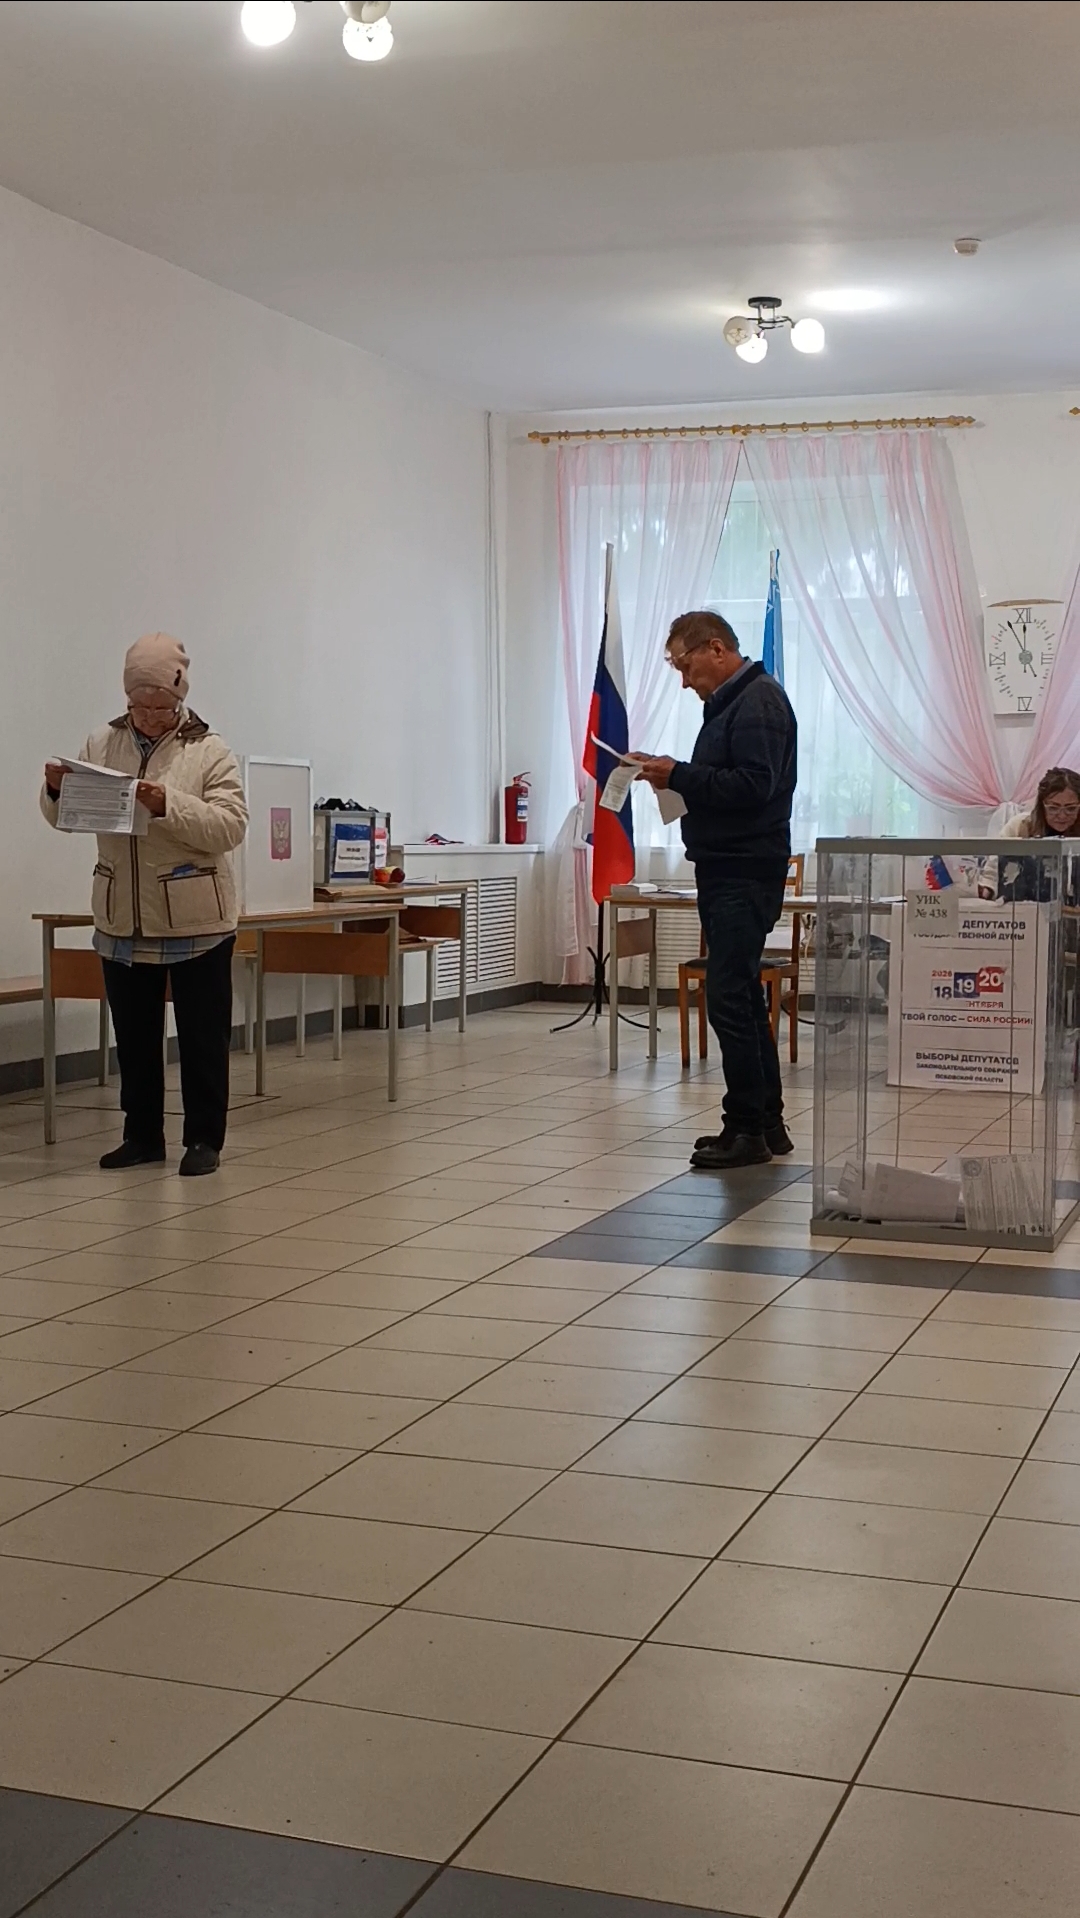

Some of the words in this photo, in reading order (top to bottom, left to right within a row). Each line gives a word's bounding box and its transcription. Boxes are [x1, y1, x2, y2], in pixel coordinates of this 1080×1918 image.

[1012, 607, 1034, 624] XII
[916, 895, 941, 904] УИК
[914, 909, 927, 918] №
[929, 909, 948, 918] 438
[962, 920, 1026, 930] ДЕПУТАТОВ
[998, 933, 1025, 941] ДУМЫ
[934, 986, 952, 1000] 18
[956, 978, 975, 993] 19
[978, 971, 1002, 987] 20
[902, 1012, 925, 1021] ТВОЙ
[927, 1014, 957, 1022] ГОЛОС
[967, 1015, 991, 1023] СИЛА
[915, 1052, 959, 1062] ВЫБОРЫ
[960, 1054, 1019, 1065] ДЕПУТАТОВ
